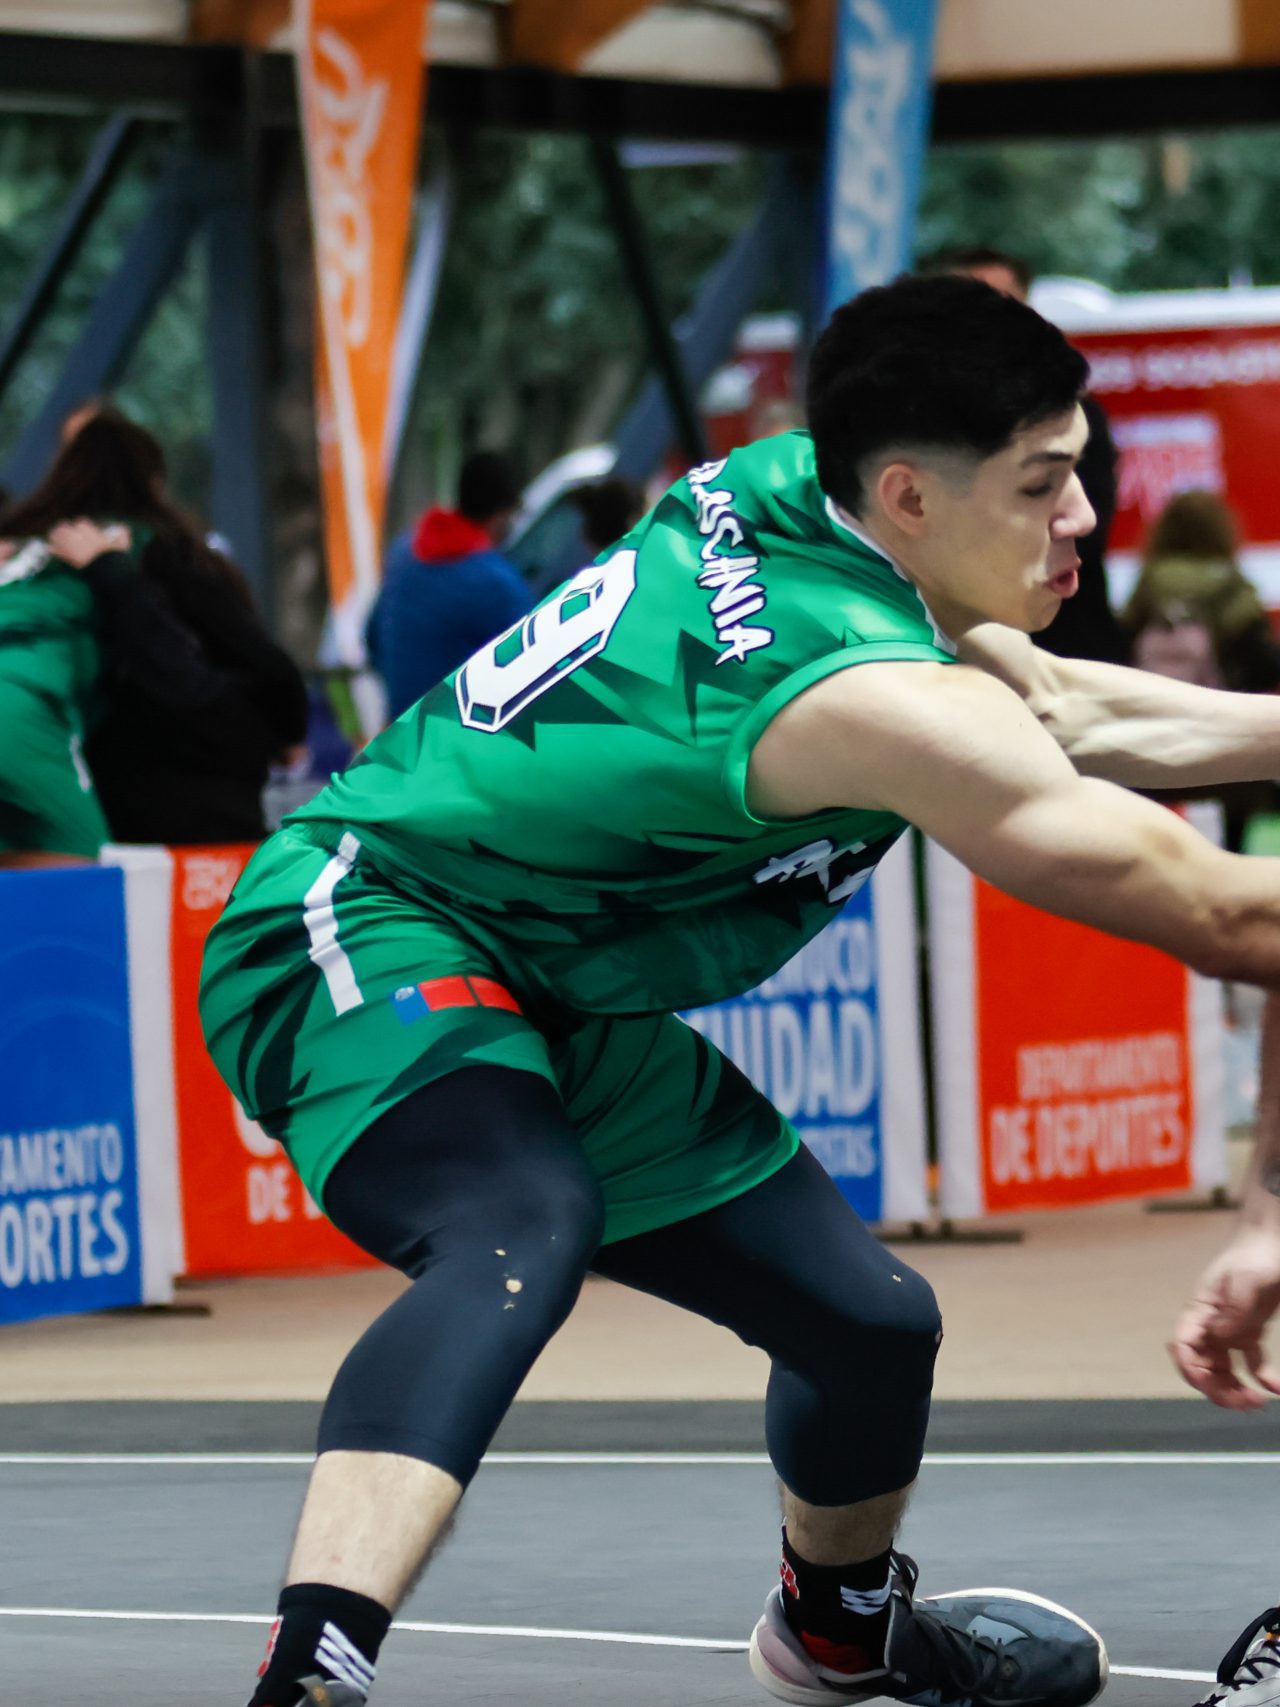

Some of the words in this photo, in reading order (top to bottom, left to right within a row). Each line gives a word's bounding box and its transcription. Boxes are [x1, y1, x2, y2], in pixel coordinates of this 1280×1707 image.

[0, 1122, 124, 1195] AMENTO
[990, 1108, 1031, 1185] DE
[248, 1164, 292, 1225] DE
